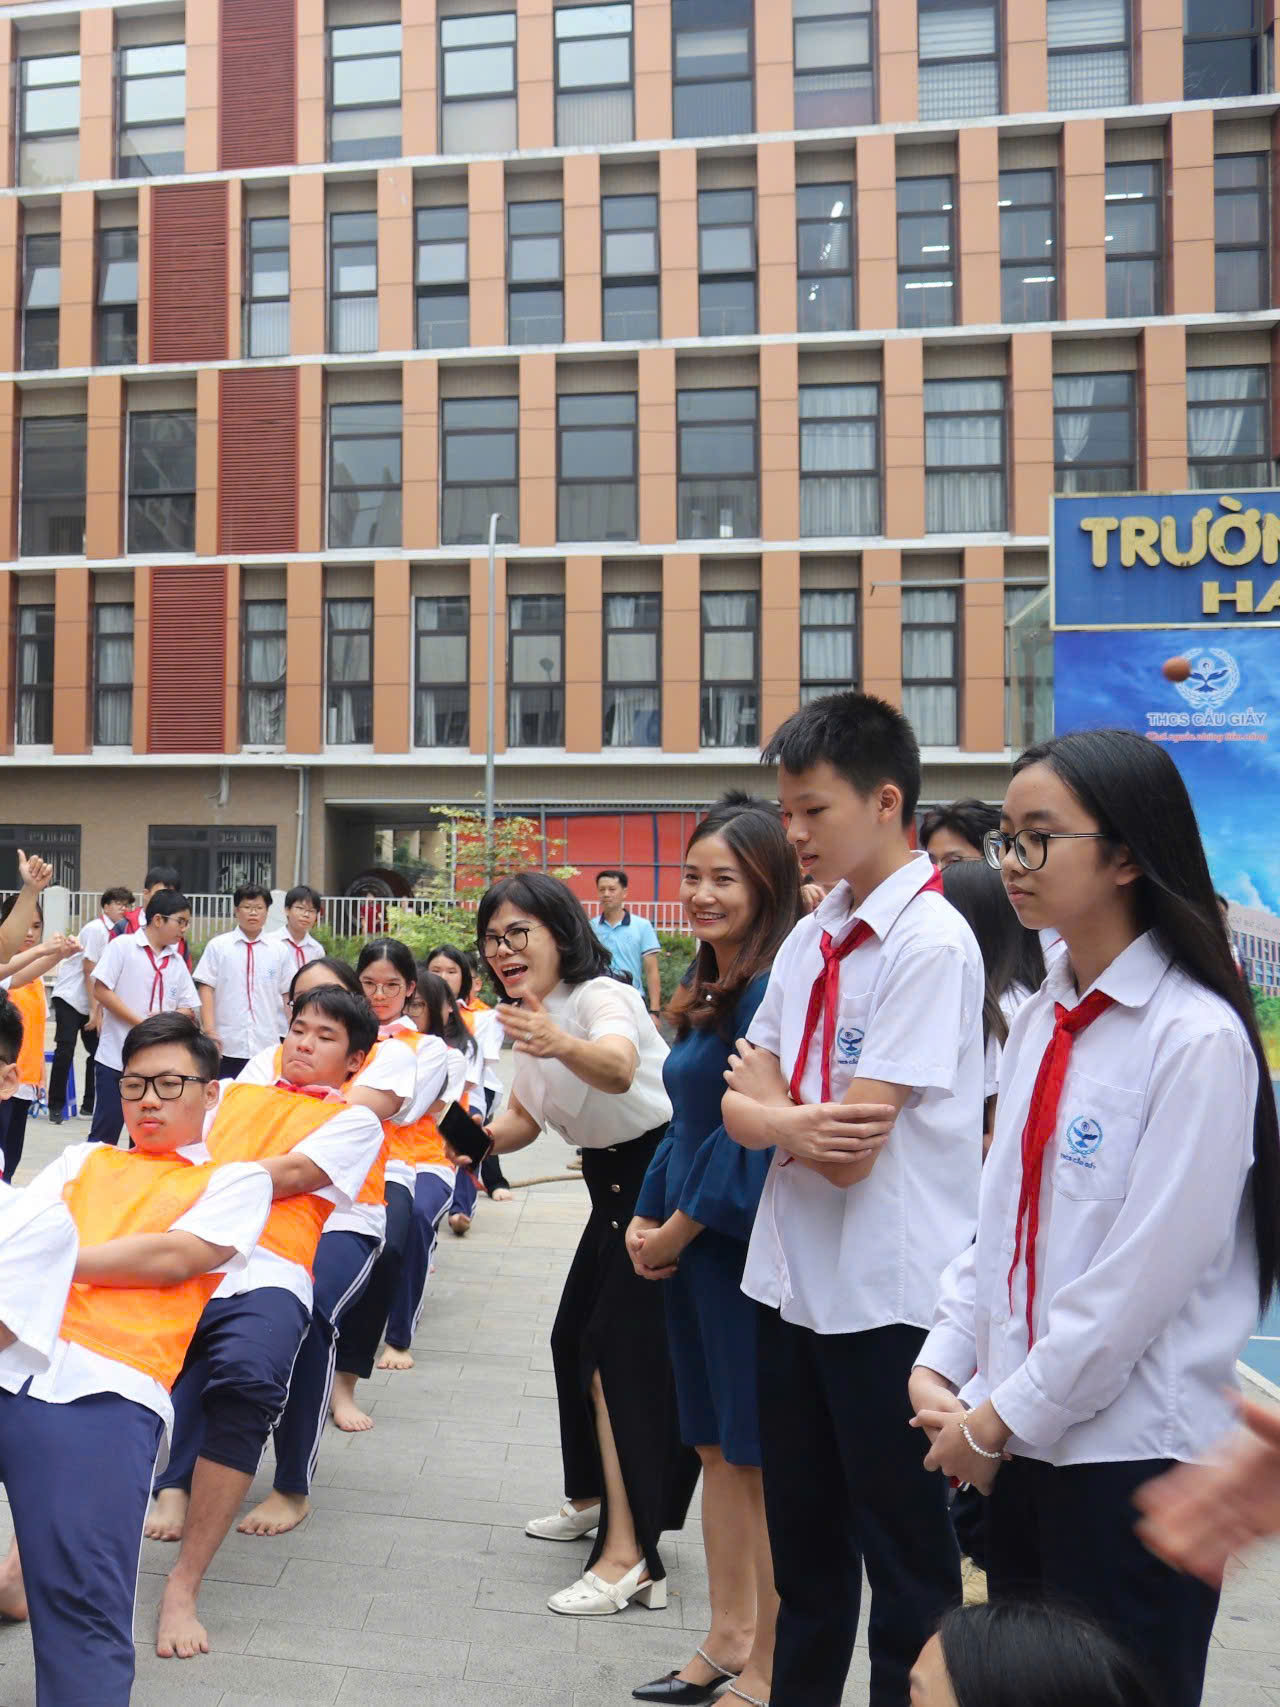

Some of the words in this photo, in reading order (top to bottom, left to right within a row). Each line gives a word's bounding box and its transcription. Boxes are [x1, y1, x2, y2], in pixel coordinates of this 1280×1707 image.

[1147, 712, 1189, 727] THCS
[1192, 708, 1225, 727] CẦU
[1229, 707, 1267, 726] GIẤY
